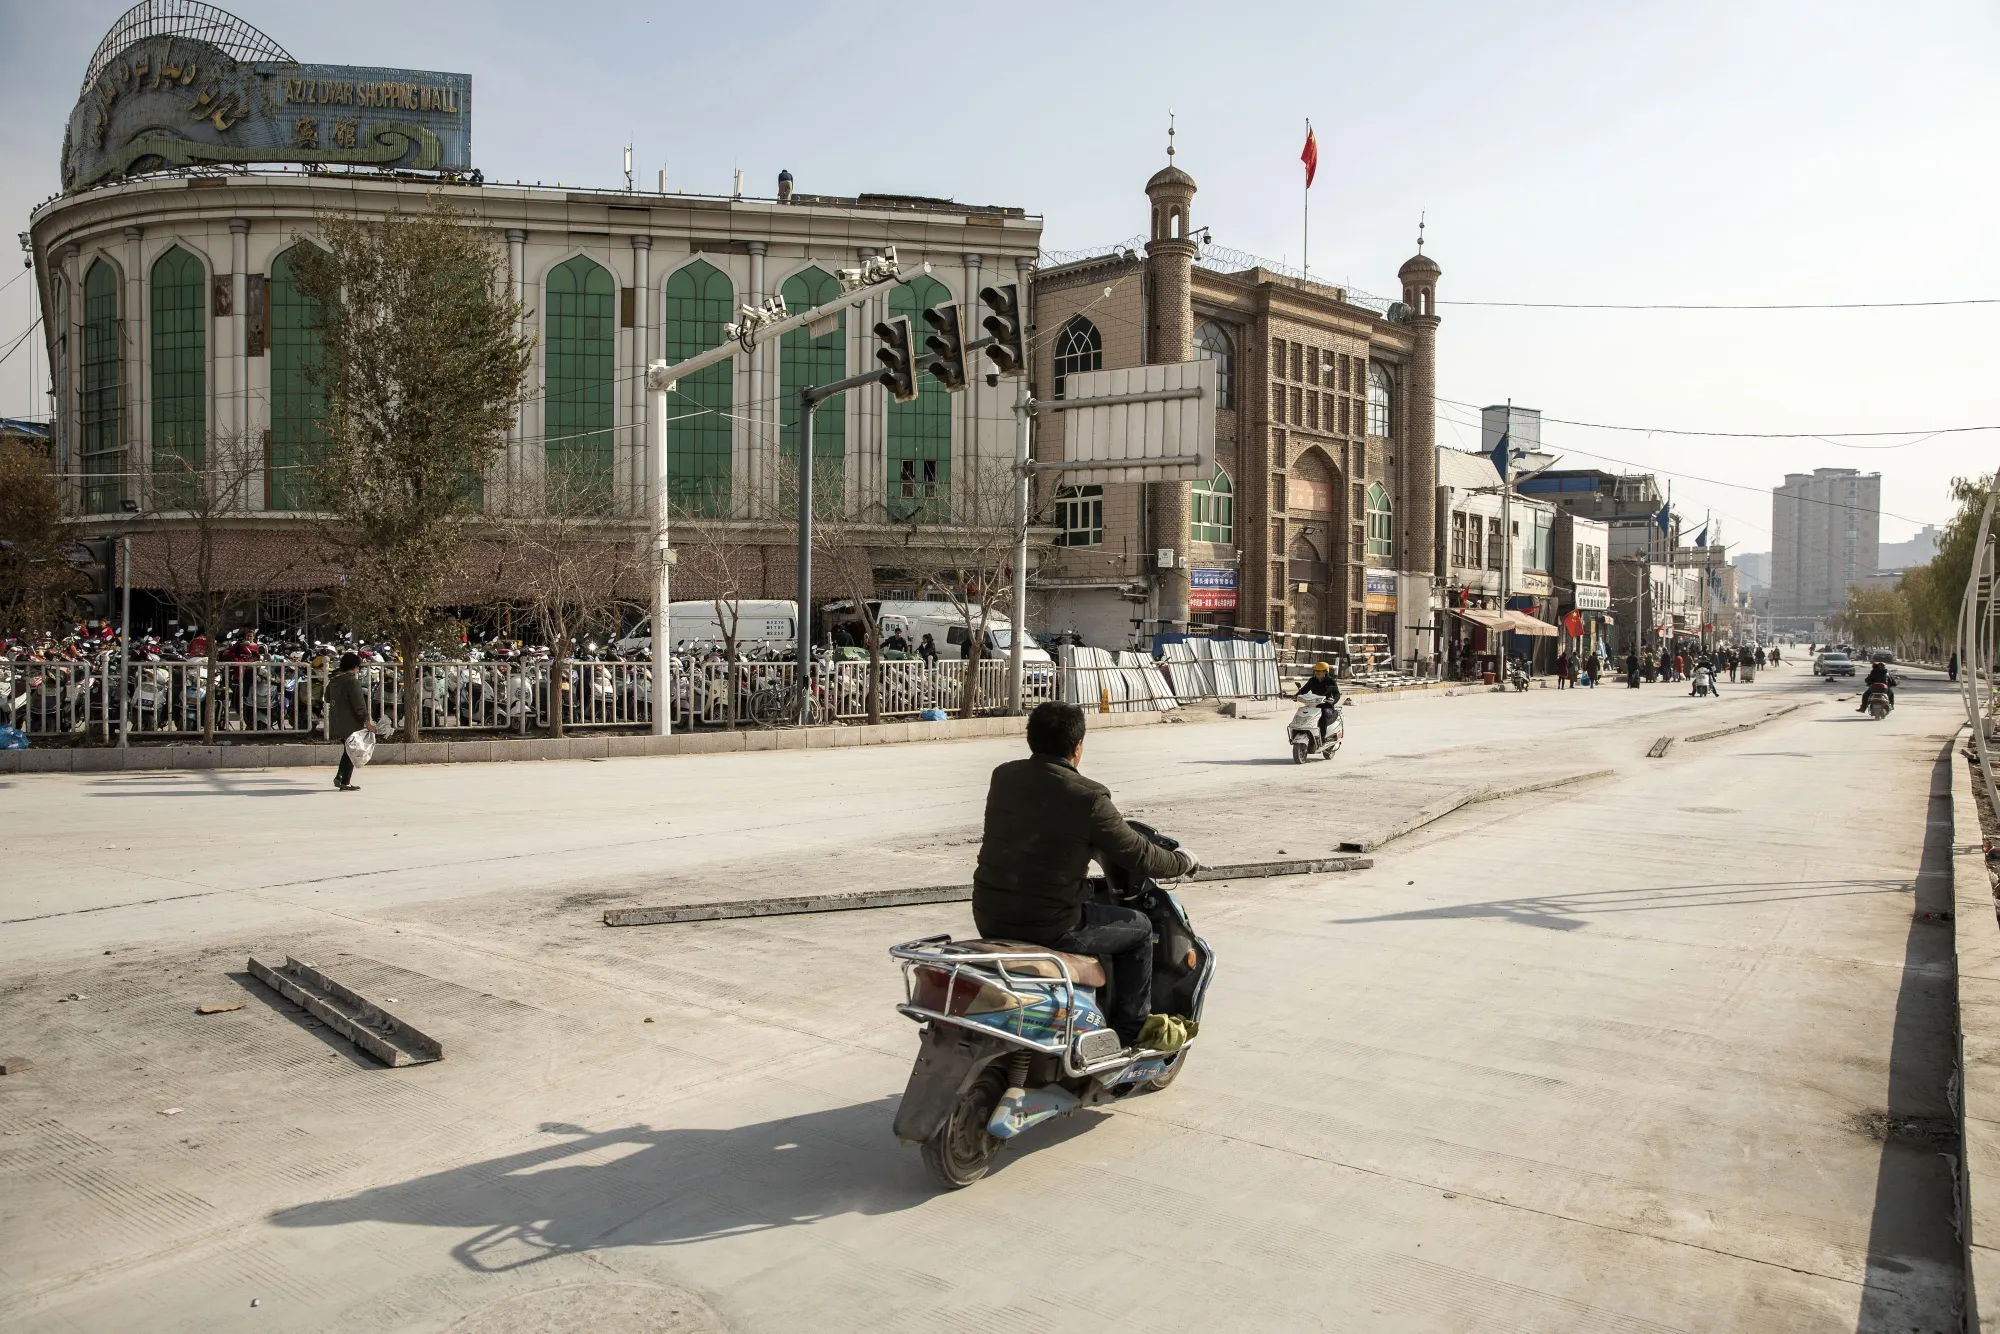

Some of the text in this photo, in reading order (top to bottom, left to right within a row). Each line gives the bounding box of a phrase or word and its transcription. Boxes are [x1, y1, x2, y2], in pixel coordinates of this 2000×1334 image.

[285, 79, 458, 113] AZIZ DYAR SHOPPING MALL
[1127, 1069, 1148, 1079] BEST
